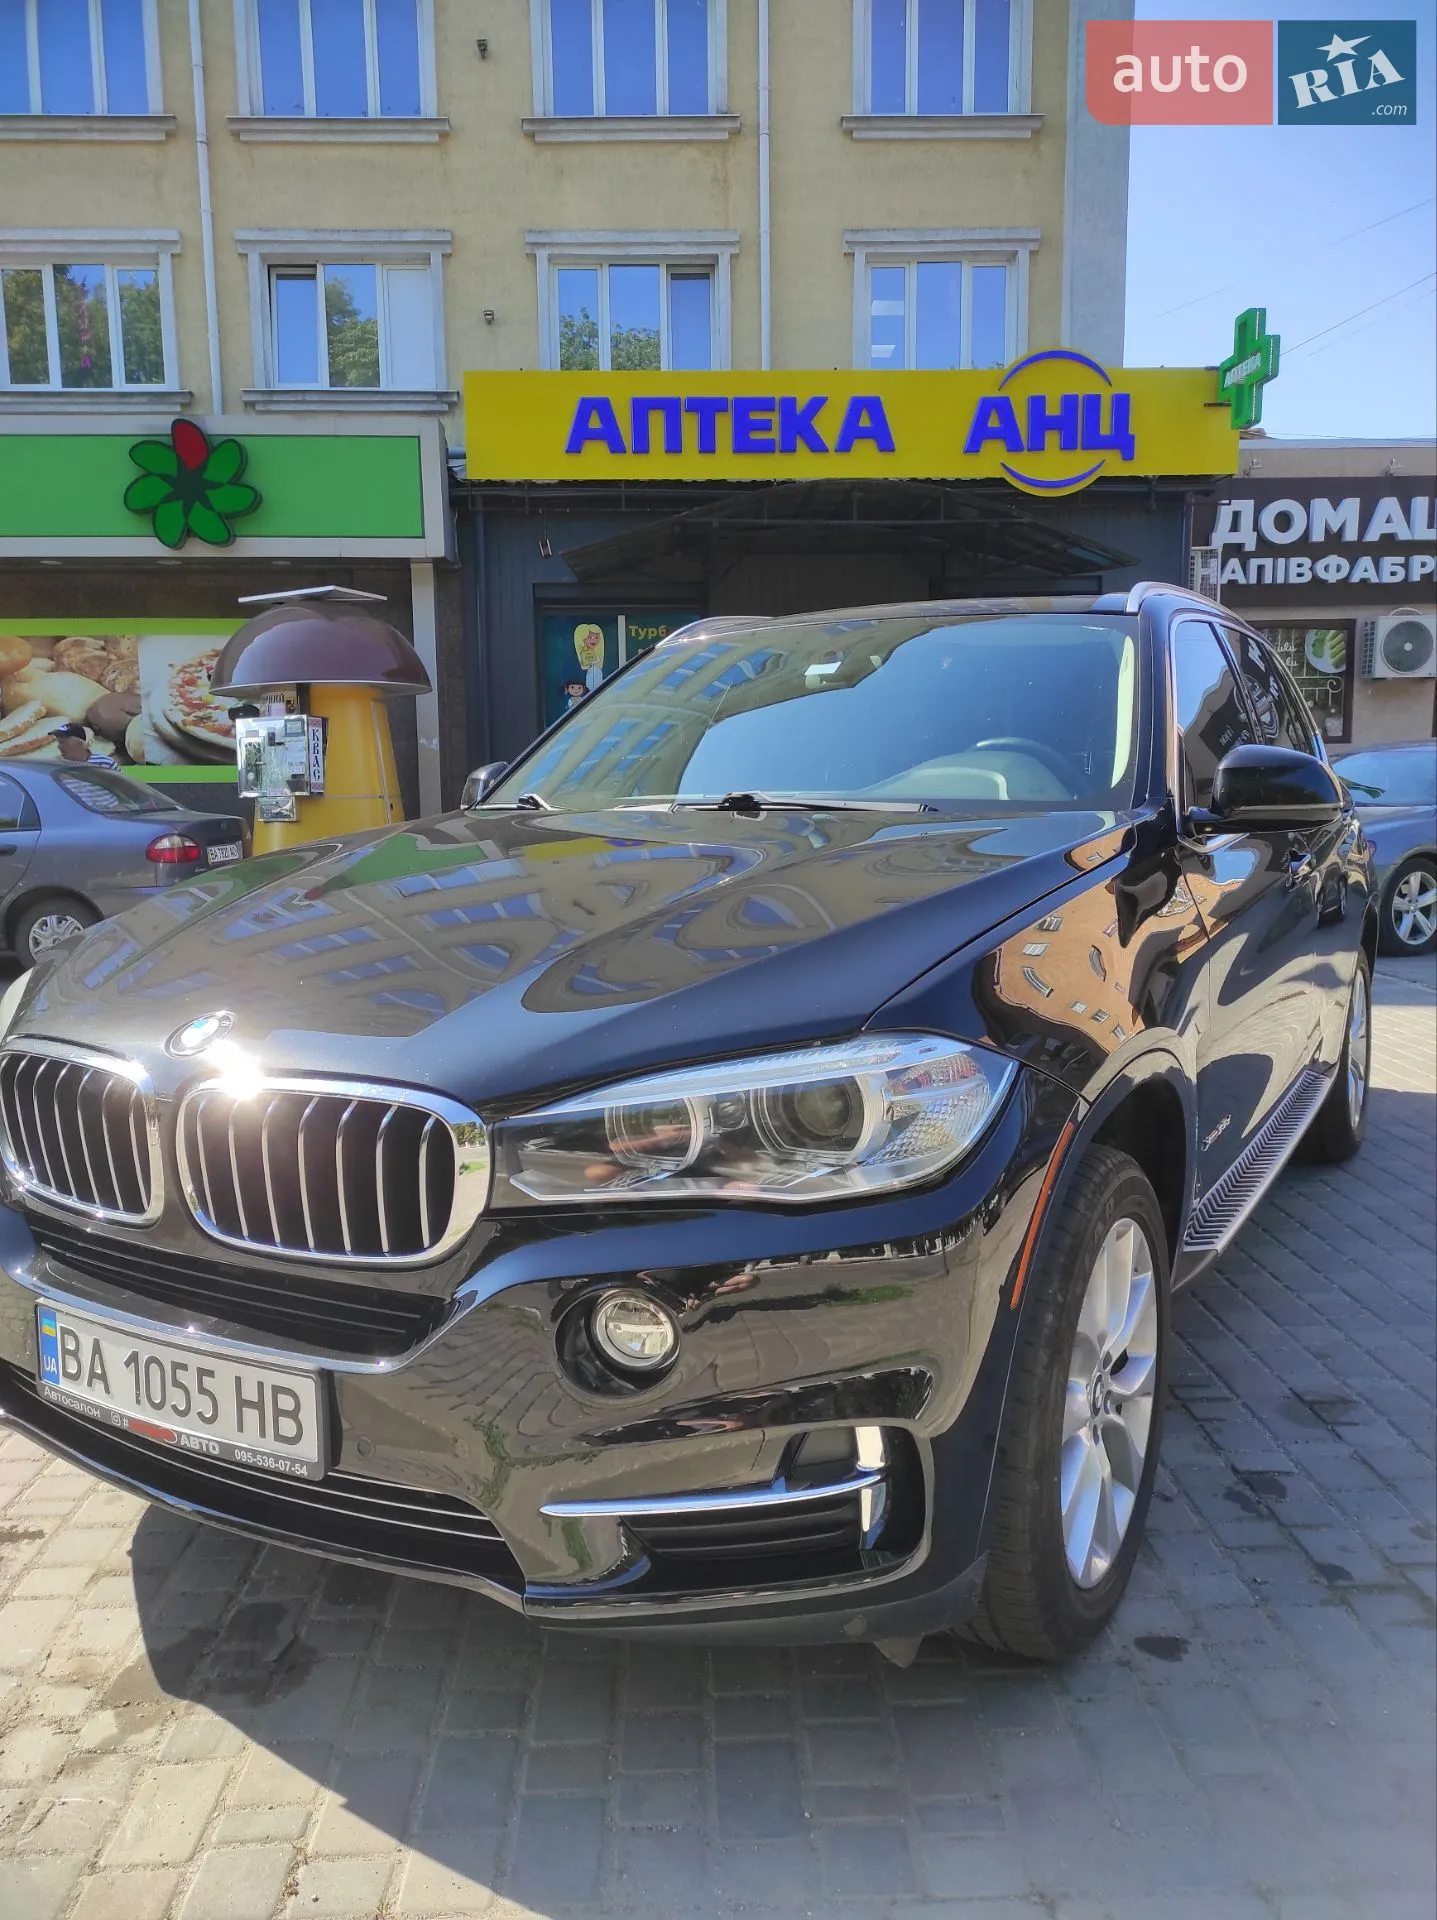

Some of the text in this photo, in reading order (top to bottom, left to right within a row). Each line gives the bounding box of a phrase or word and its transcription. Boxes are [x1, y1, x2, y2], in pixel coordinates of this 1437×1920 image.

[565, 393, 1136, 461] АПТЕКА АНЦ
[1197, 554, 1437, 585] НАПІВФАБР
[44, 1354, 58, 1376] UA
[60, 1325, 304, 1446] BA 1055 HB
[44, 1386, 309, 1477] Автосалон АВТО 095-536-07-54
